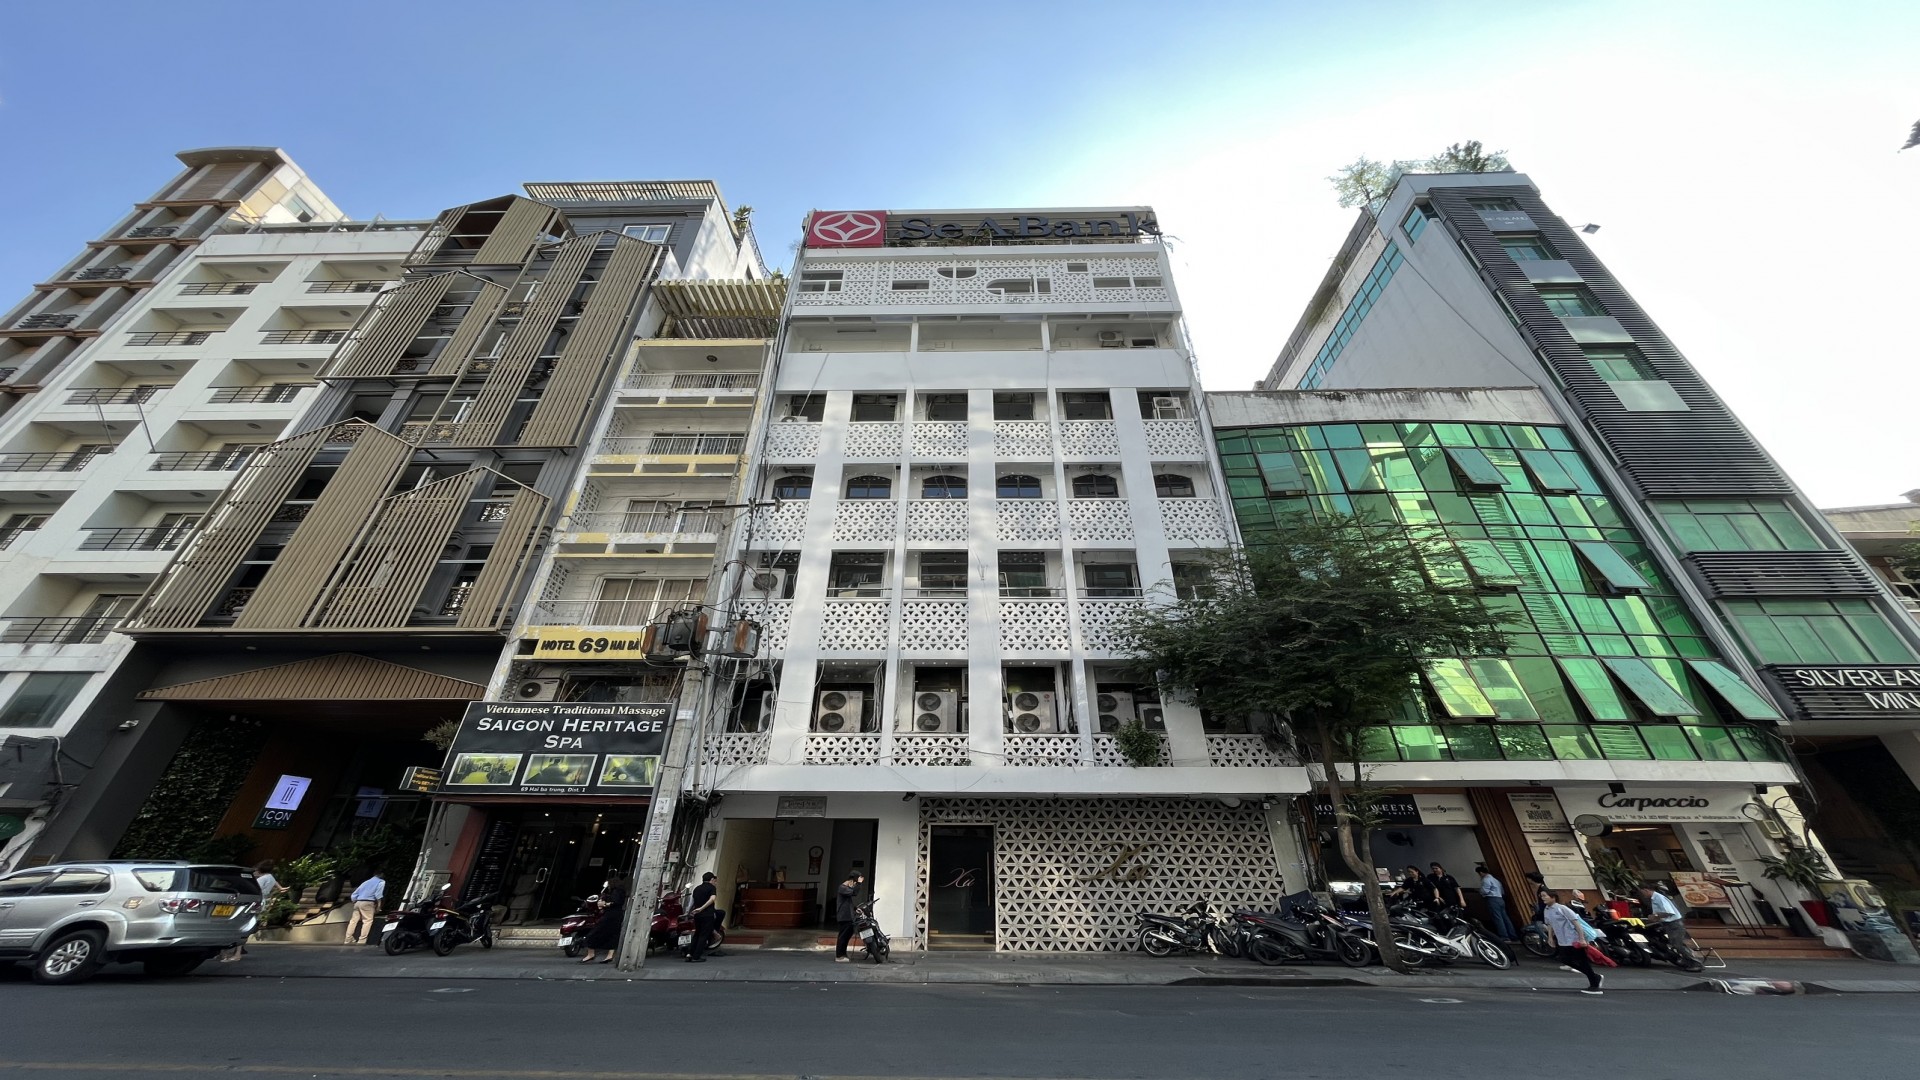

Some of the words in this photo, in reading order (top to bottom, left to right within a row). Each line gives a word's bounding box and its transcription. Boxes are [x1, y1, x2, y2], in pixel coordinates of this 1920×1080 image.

[540, 640, 575, 651] HOTEL
[578, 637, 609, 653] 69
[609, 640, 626, 651] HAI
[486, 705, 549, 715] Vietnamese
[552, 705, 615, 715] Traditional
[617, 706, 666, 717] Massage
[476, 717, 555, 732] SAIGON
[562, 718, 664, 733] HERITAGE
[544, 734, 583, 749] SPA
[1598, 792, 1709, 811] Carpaccio
[262, 810, 292, 821] ICON
